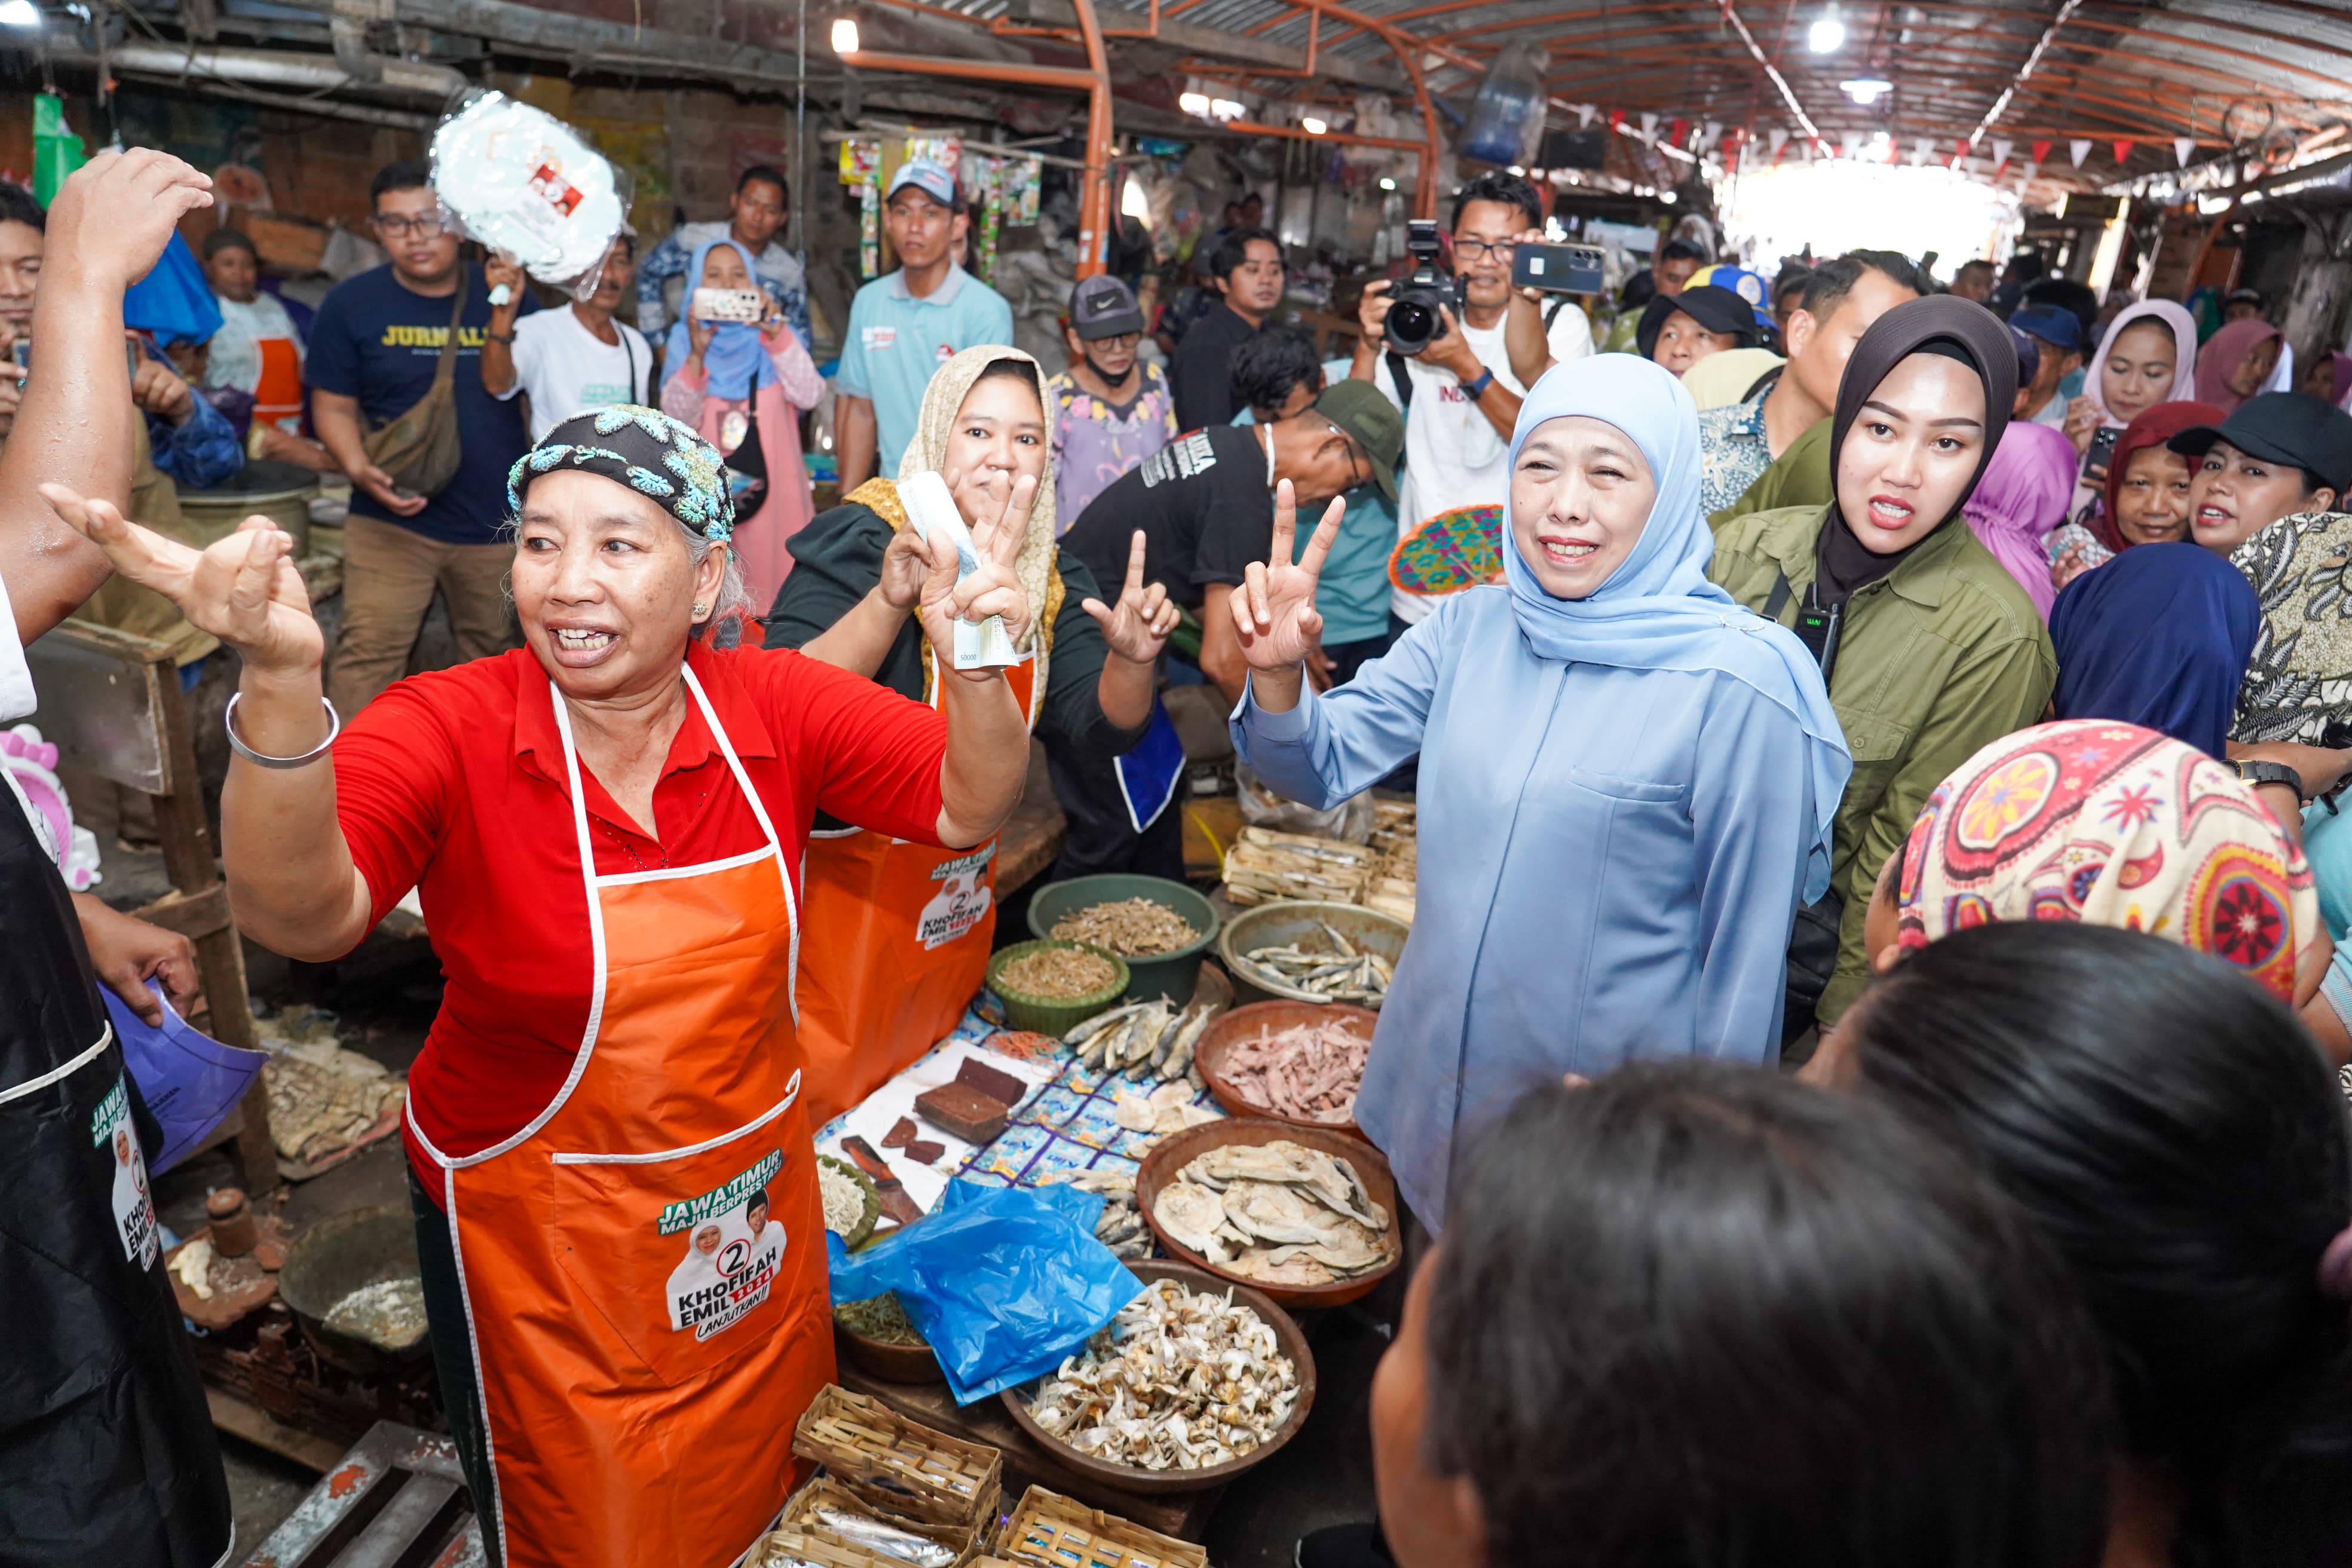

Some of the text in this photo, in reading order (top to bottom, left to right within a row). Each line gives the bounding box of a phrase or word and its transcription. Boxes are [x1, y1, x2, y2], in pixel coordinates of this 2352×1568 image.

[954, 893, 967, 910] 2
[92, 1085, 122, 1133] JAWA
[659, 1149, 780, 1224] JAWA TIMUR
[1046, 1154, 1079, 1169] Klin
[661, 1158, 782, 1235] MAJU BERPRESTASI
[679, 1245, 776, 1312] KHOFIFAH
[725, 1242, 745, 1274] 2
[680, 1271, 771, 1328] EMIL 2024
[697, 1284, 767, 1338] LANJUTKAN!!
